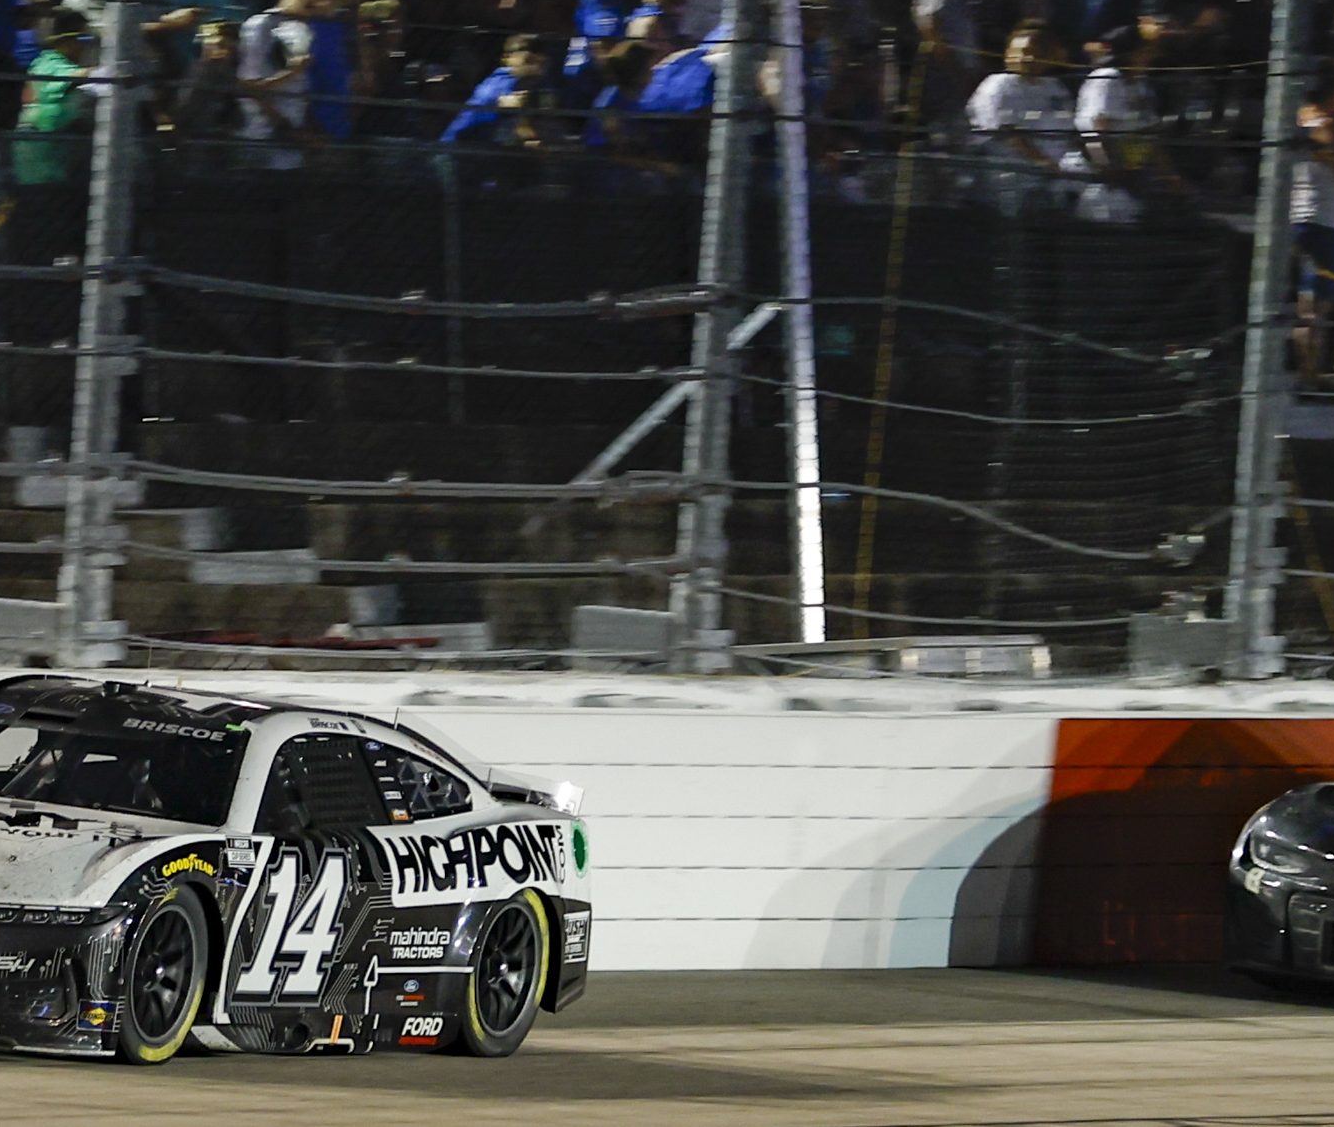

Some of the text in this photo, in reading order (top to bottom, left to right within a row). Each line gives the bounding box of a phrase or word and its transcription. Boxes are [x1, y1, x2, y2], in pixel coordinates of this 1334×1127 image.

[122, 717, 228, 742] BRISCOE
[162, 853, 215, 877] GOODYEAR
[384, 824, 557, 894] HIGHPOINT
[232, 850, 349, 1003] 14
[389, 927, 450, 946] mahindra
[392, 946, 444, 959] TRACTORS
[401, 1017, 443, 1036] FORD
